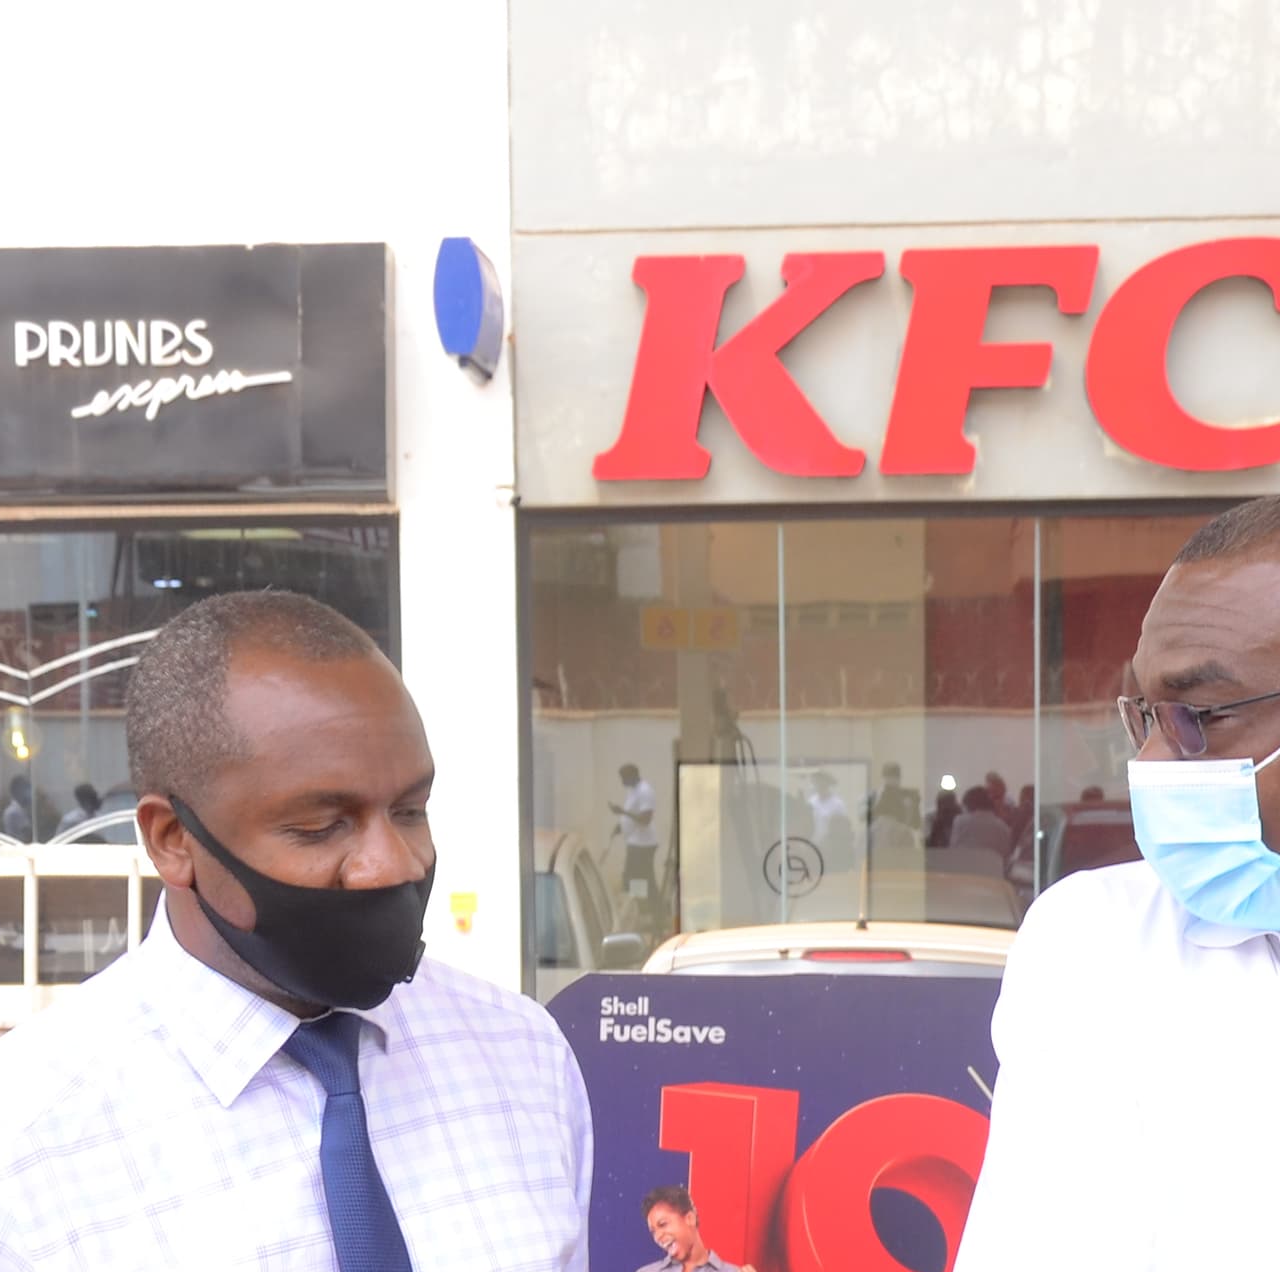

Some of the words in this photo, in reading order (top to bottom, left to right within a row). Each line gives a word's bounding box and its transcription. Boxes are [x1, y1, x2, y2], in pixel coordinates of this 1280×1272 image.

[15, 319, 213, 366] PRUNES
[600, 996, 649, 1016] Shell
[599, 1017, 726, 1045] FuelSave
